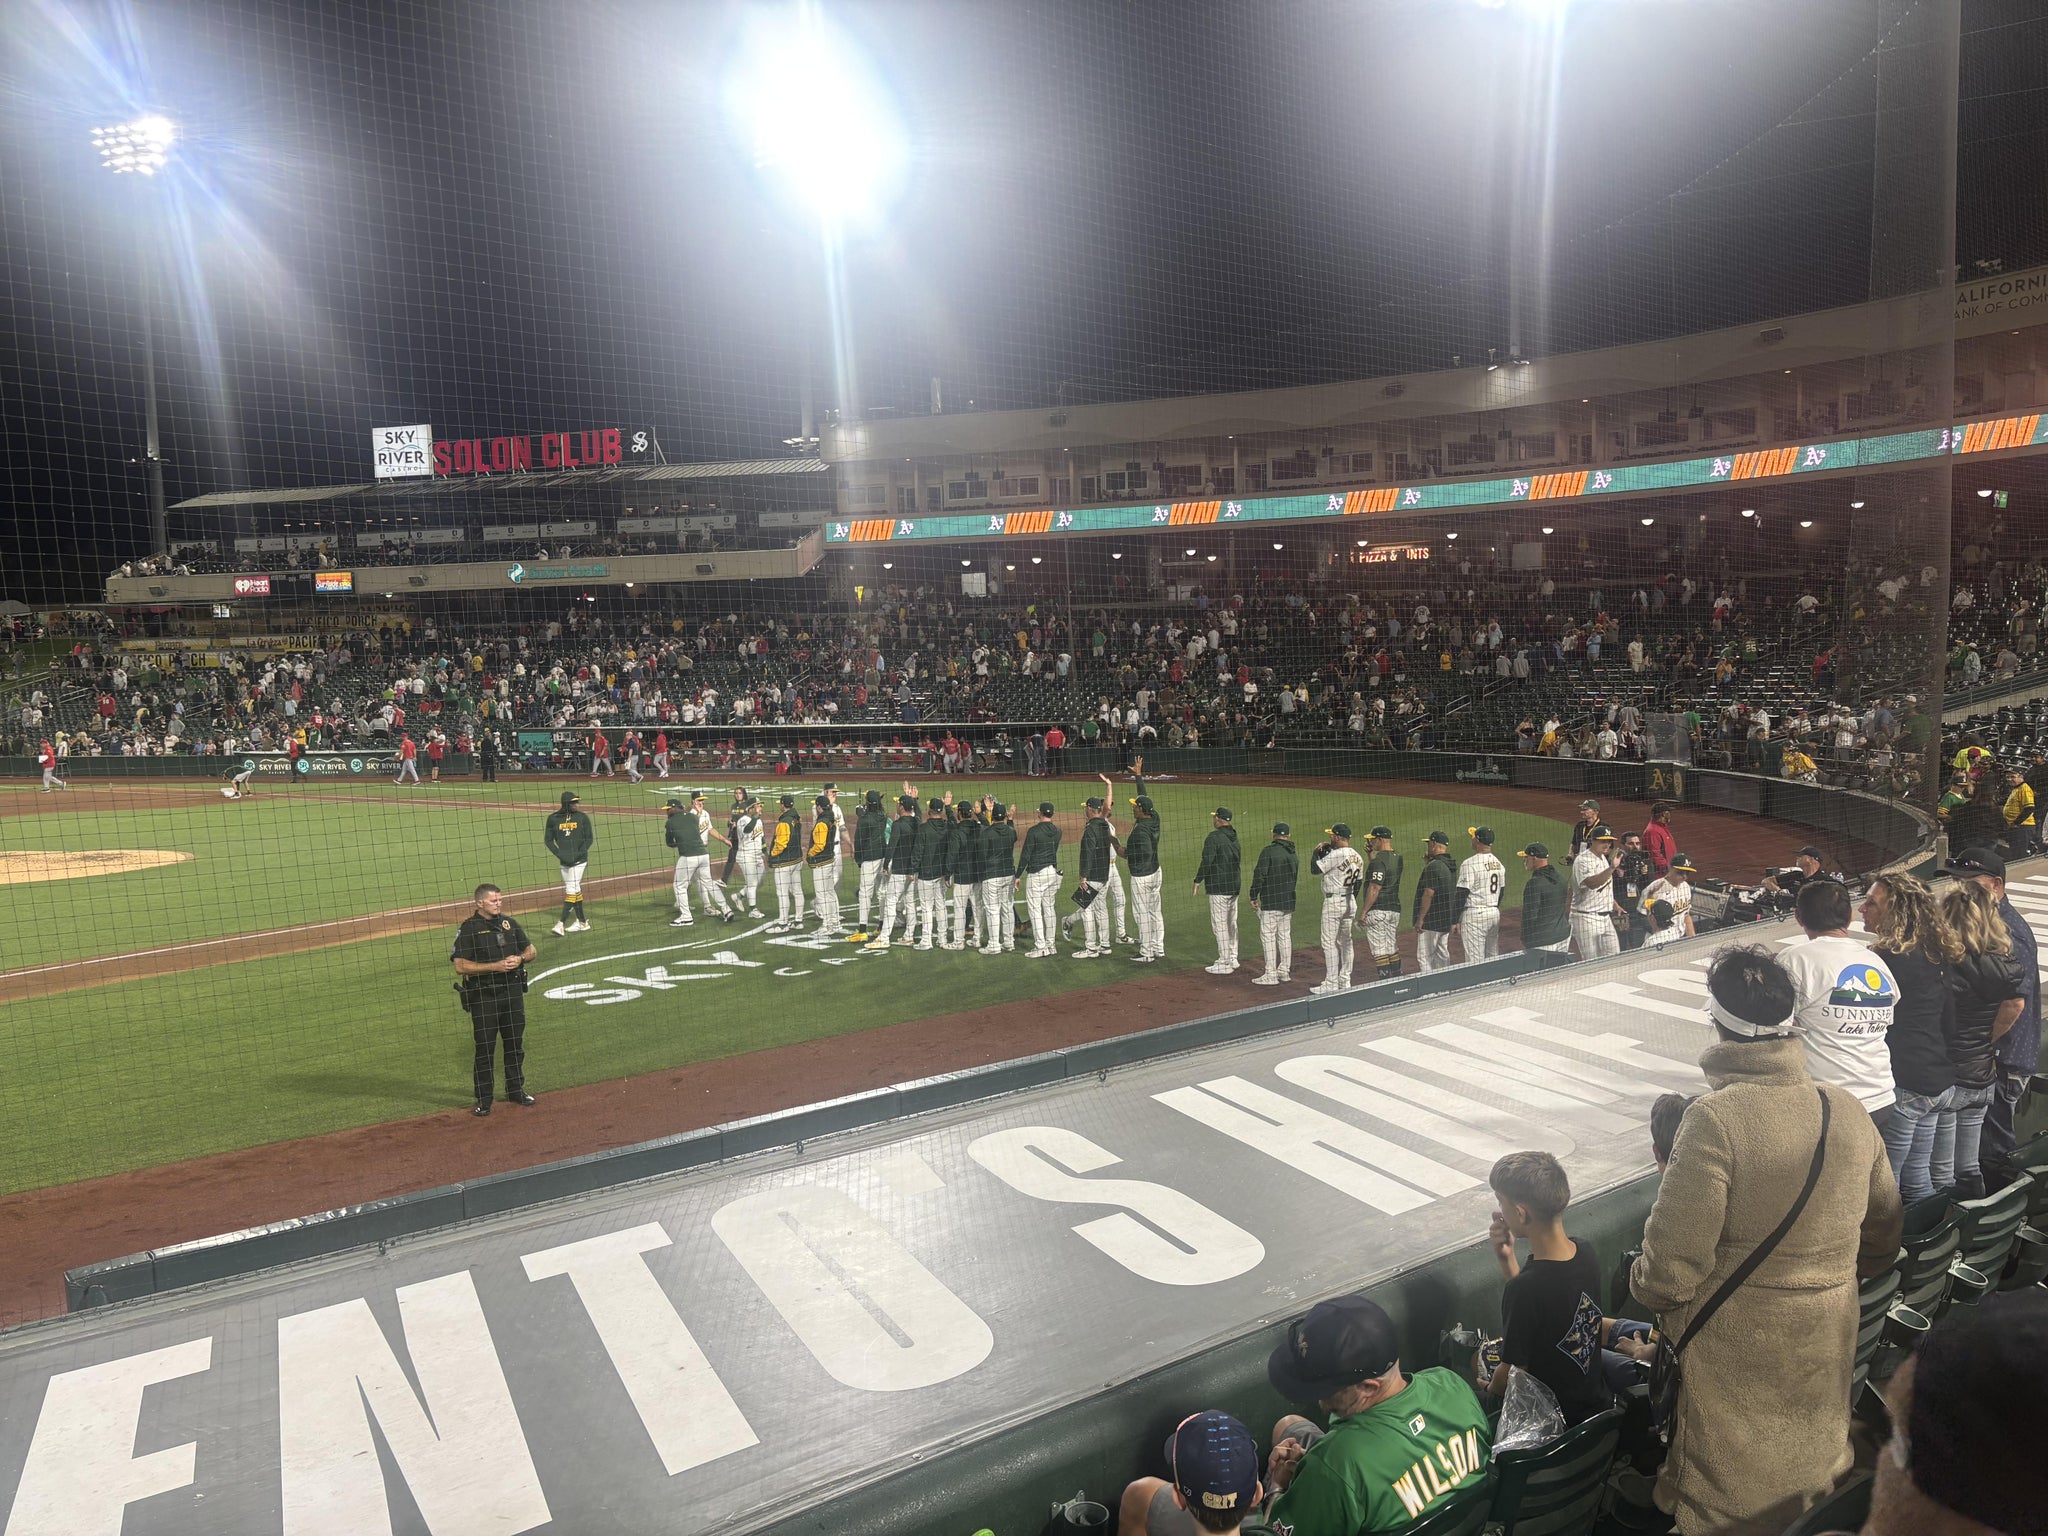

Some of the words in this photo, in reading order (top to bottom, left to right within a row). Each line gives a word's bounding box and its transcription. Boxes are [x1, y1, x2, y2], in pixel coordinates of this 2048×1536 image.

[1957, 274, 2048, 305] ALIFORNI
[1955, 305, 1979, 319] ANK
[1985, 301, 2003, 314] OF
[385, 430, 415, 444] SKY
[378, 451, 425, 465] RIVER
[433, 435, 532, 475] SOLON
[542, 428, 622, 468] CLUB
[1402, 548, 1429, 560] INTS
[295, 616, 339, 627] PACIFICO
[346, 615, 377, 627] PORCH
[169, 653, 206, 667] PCH
[274, 763, 291, 771] RIVE
[327, 763, 347, 771] RIVER
[1648, 768, 1673, 791] A's
[1343, 868, 1361, 887] 28
[1372, 871, 1384, 881] 55
[1490, 873, 1498, 894] 8
[1838, 1022, 1864, 1035] Lake
[1392, 1427, 1480, 1520] WILSON
[1202, 1491, 1238, 1509] GRIT
